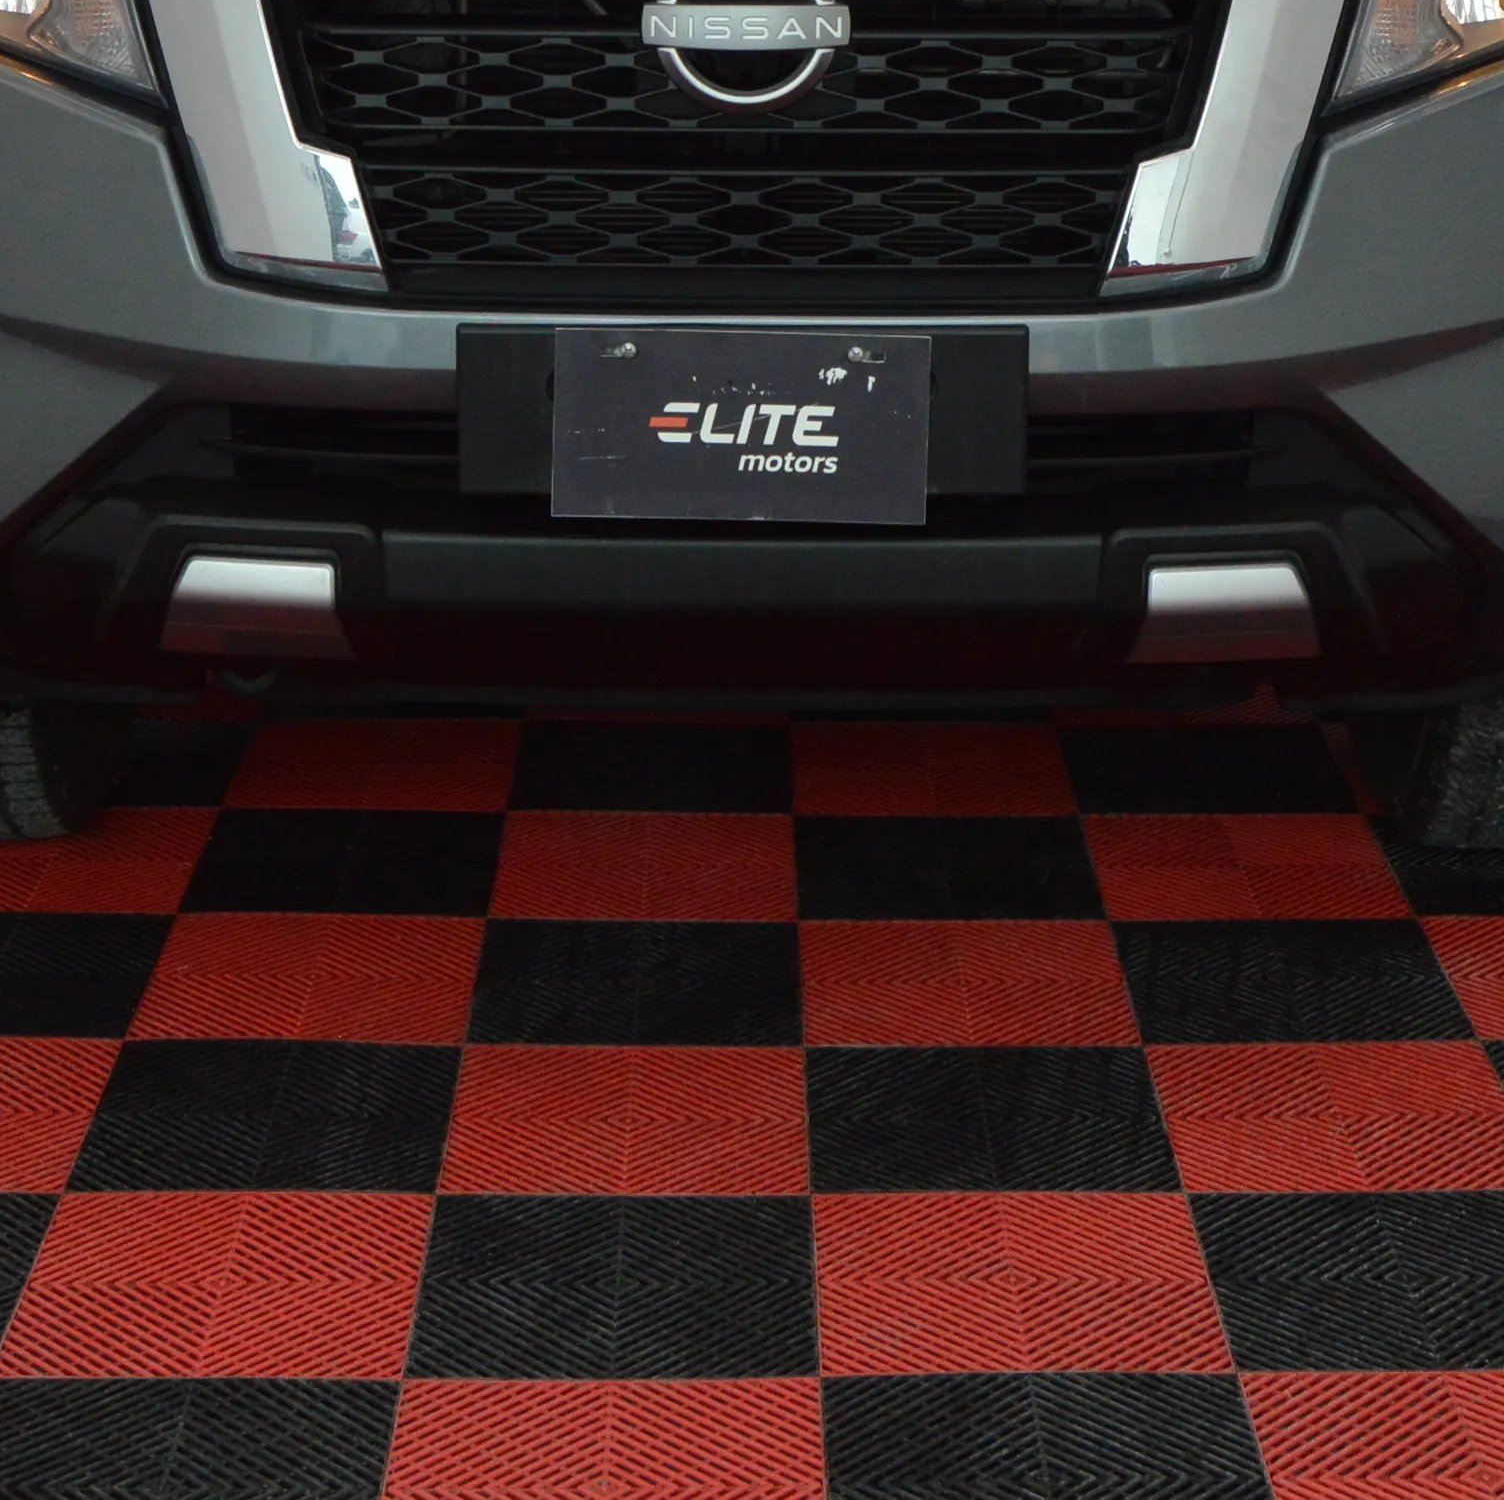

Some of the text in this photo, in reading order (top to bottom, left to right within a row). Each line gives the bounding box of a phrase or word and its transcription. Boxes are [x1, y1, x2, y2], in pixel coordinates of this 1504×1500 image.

[650, 14, 844, 40] NISSAN
[648, 401, 840, 448] ELITE
[737, 451, 840, 475] motors
